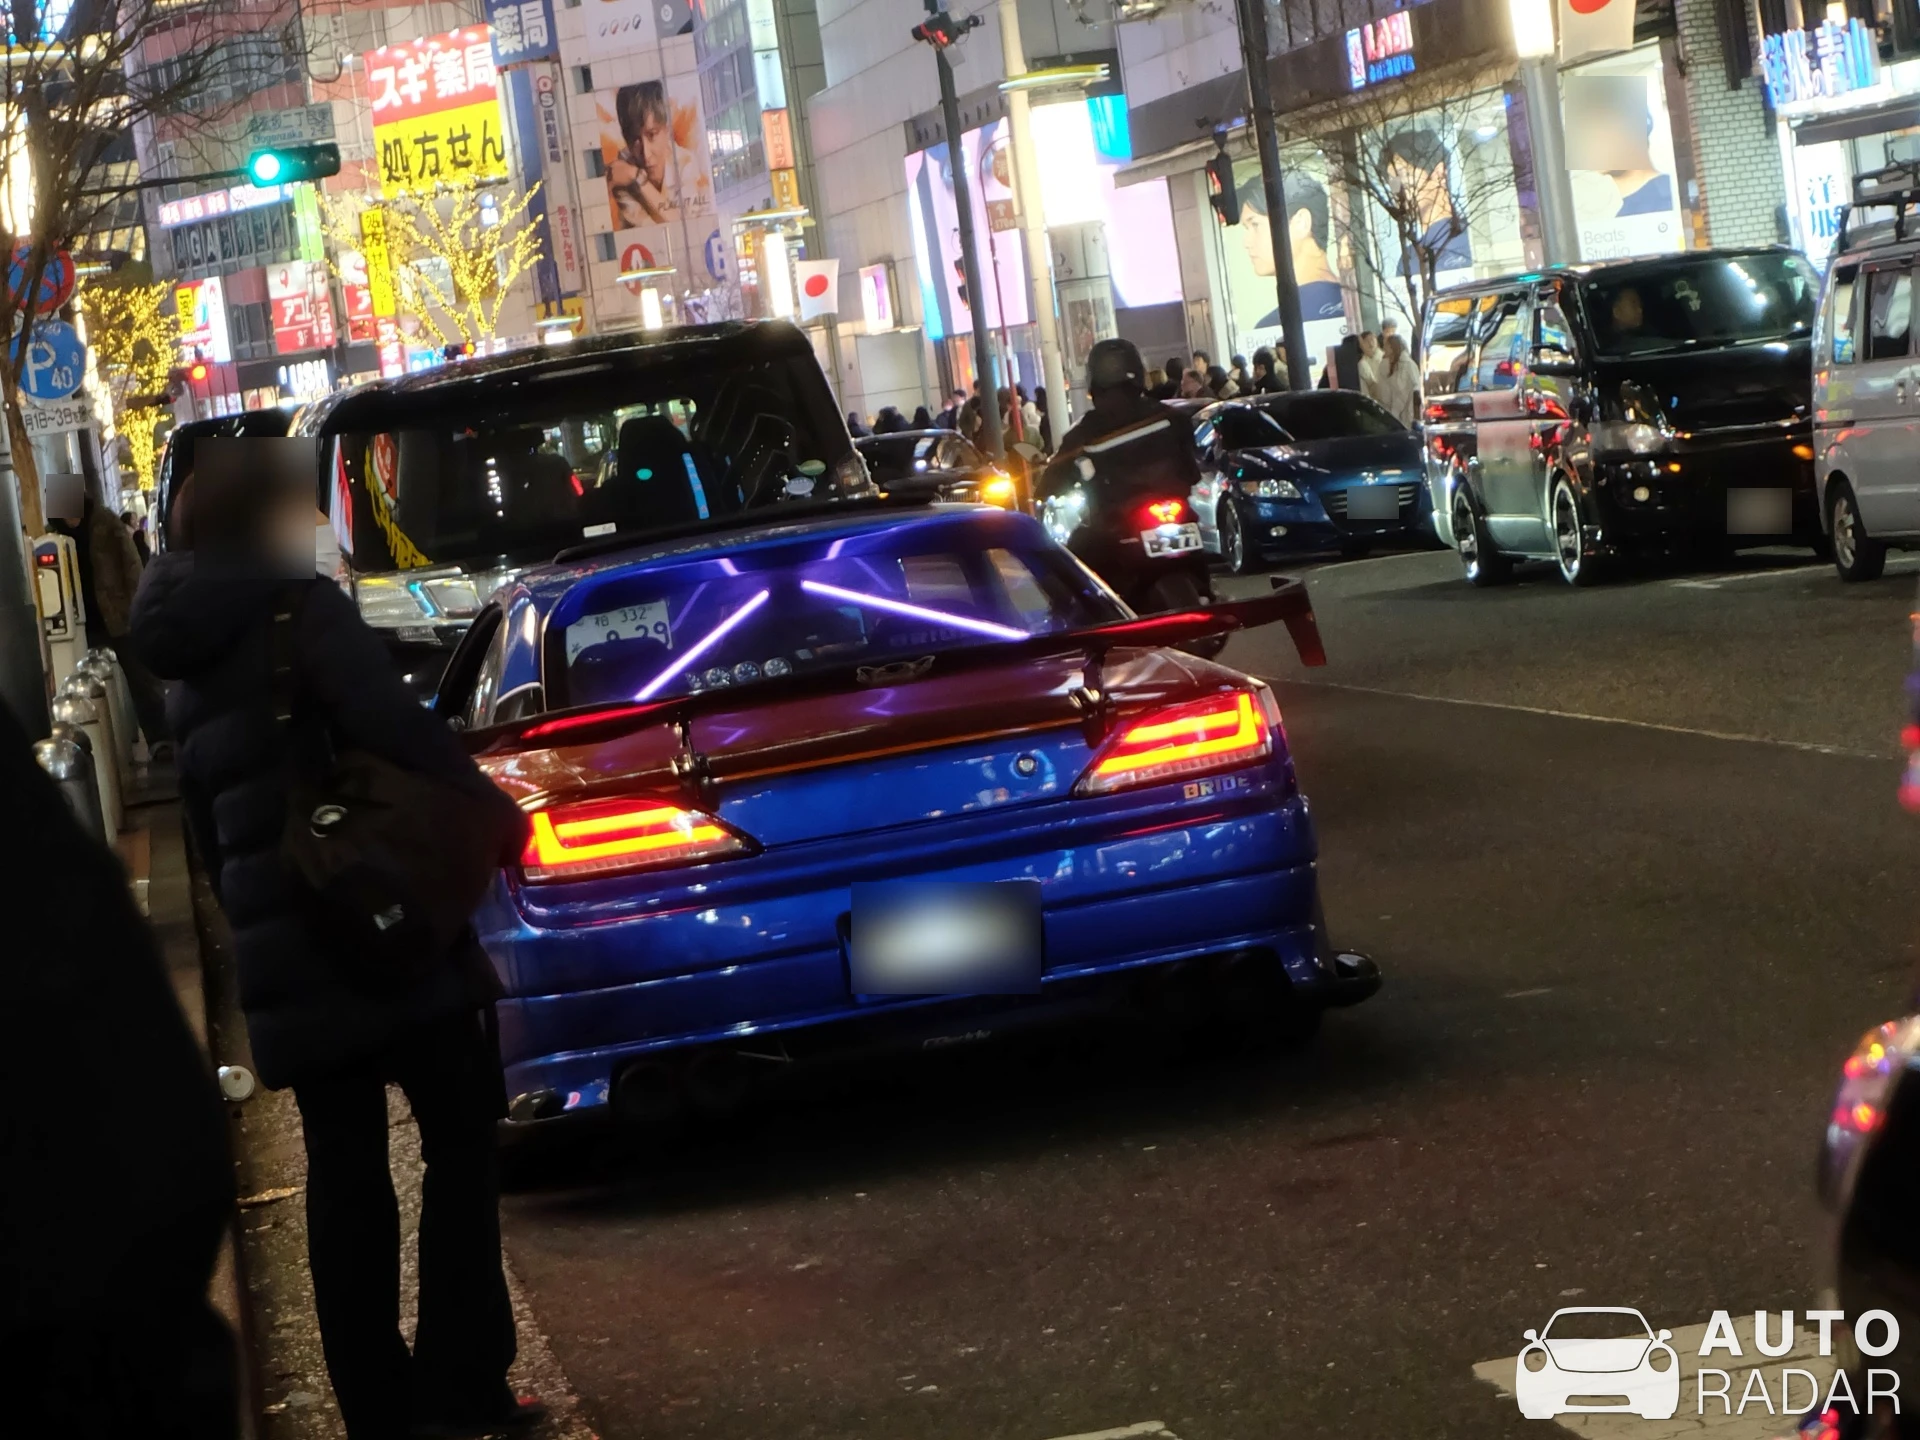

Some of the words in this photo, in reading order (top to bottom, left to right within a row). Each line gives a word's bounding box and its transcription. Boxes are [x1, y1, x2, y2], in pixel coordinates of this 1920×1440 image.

[493, 1, 548, 56] 薬局
[371, 42, 495, 112] スギ薬局
[383, 119, 505, 184] 処方せん
[1583, 228, 1625, 245] Beats
[1585, 245, 1630, 260] Studio
[26, 342, 56, 393] P
[51, 365, 74, 389] 40
[619, 606, 647, 623] 332
